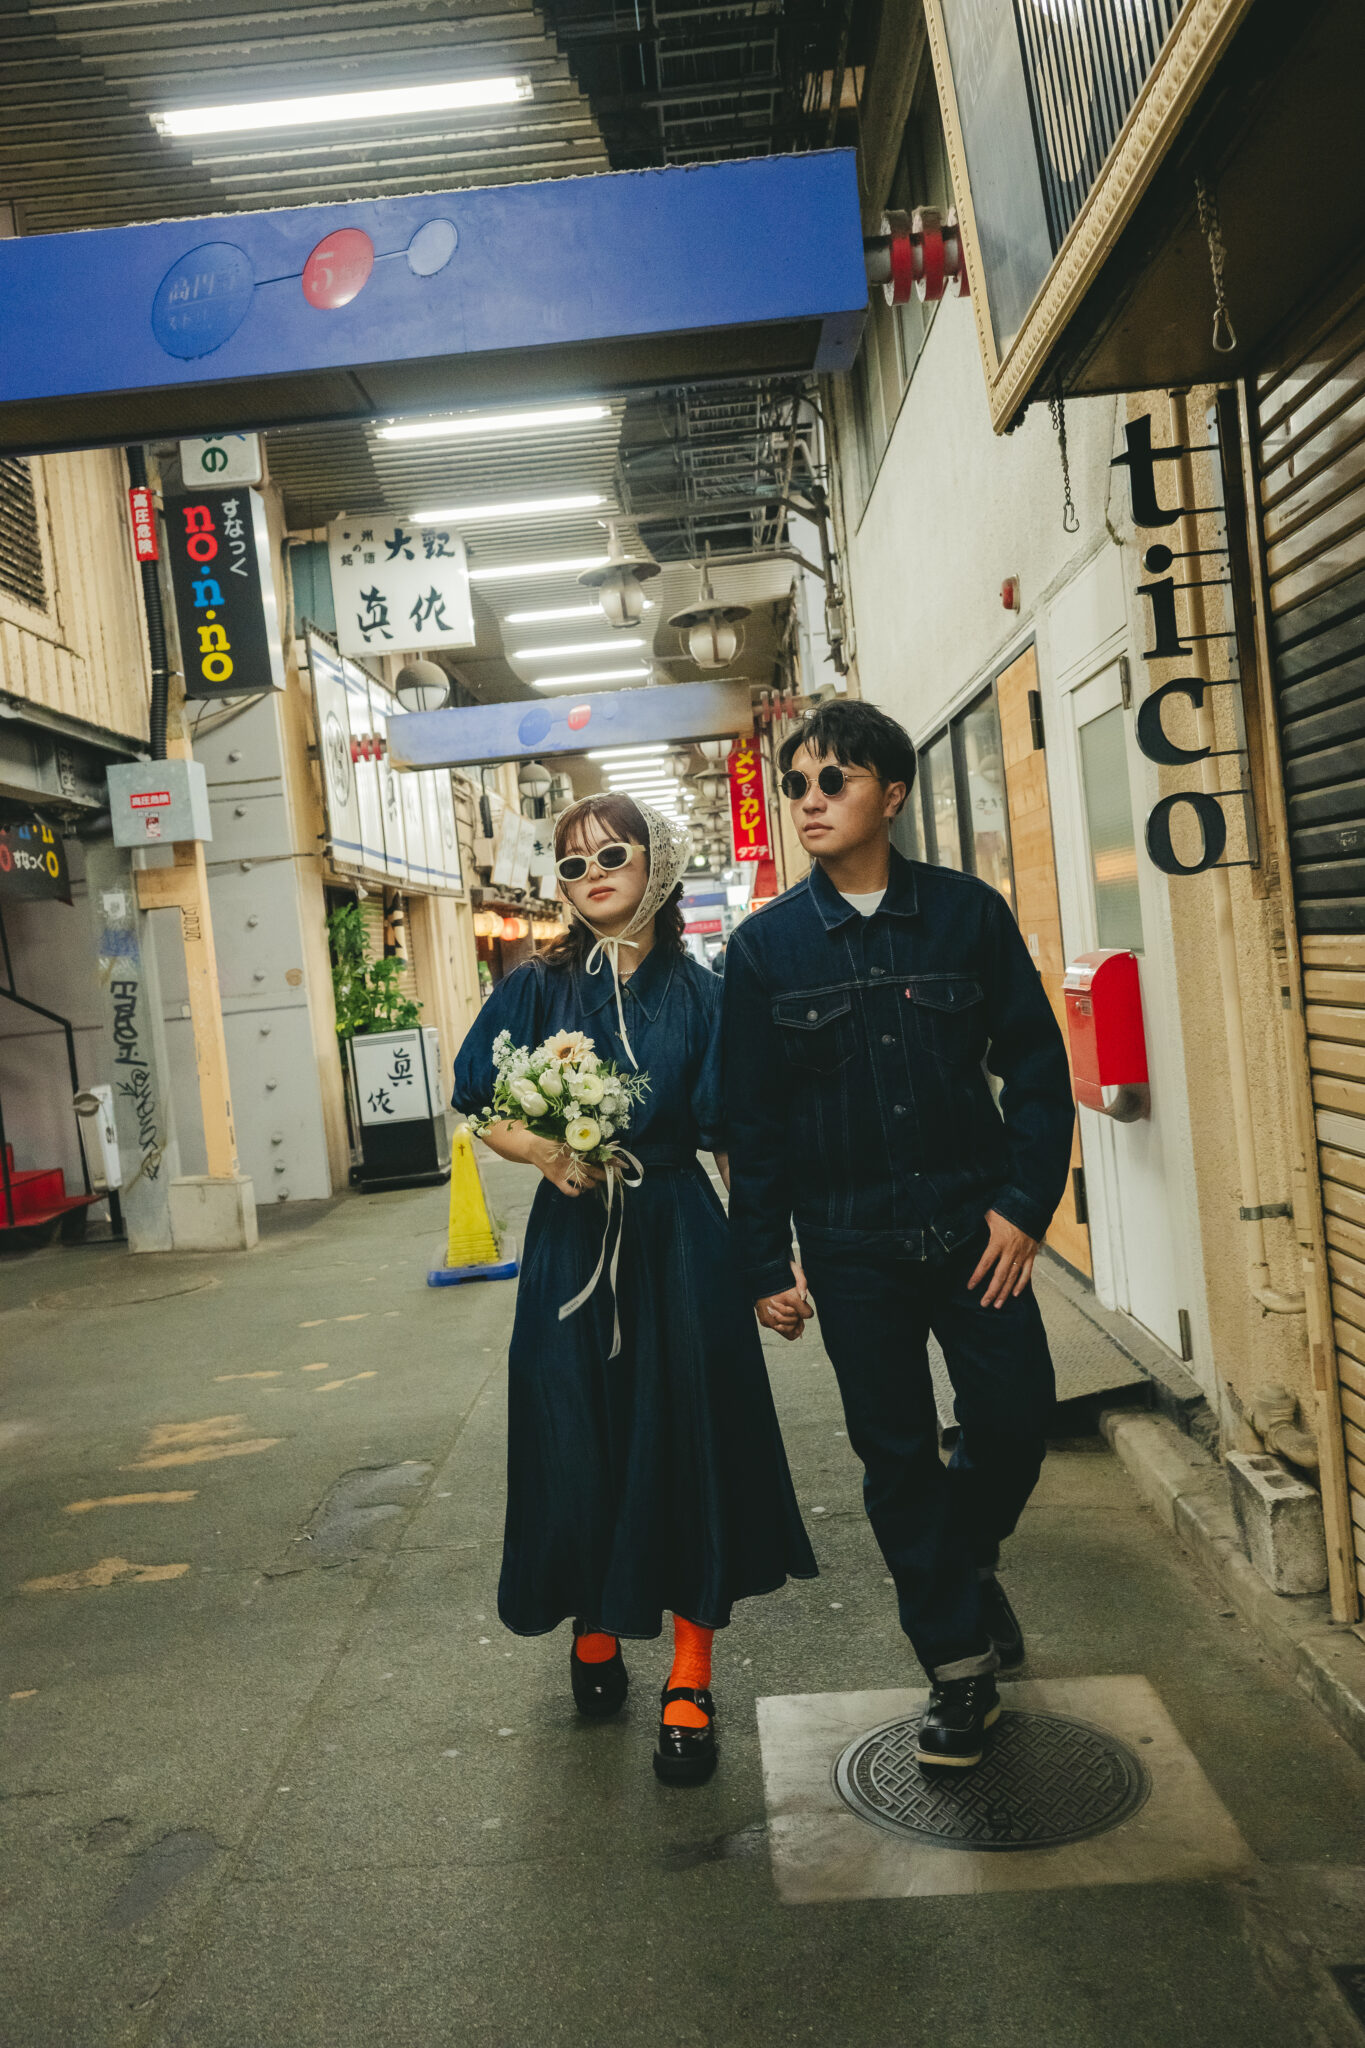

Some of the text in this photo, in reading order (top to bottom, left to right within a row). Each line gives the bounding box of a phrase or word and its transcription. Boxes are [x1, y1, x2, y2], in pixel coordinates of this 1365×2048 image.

[132, 493, 154, 555] 高圧危険
[1110, 413, 1227, 877] tico
